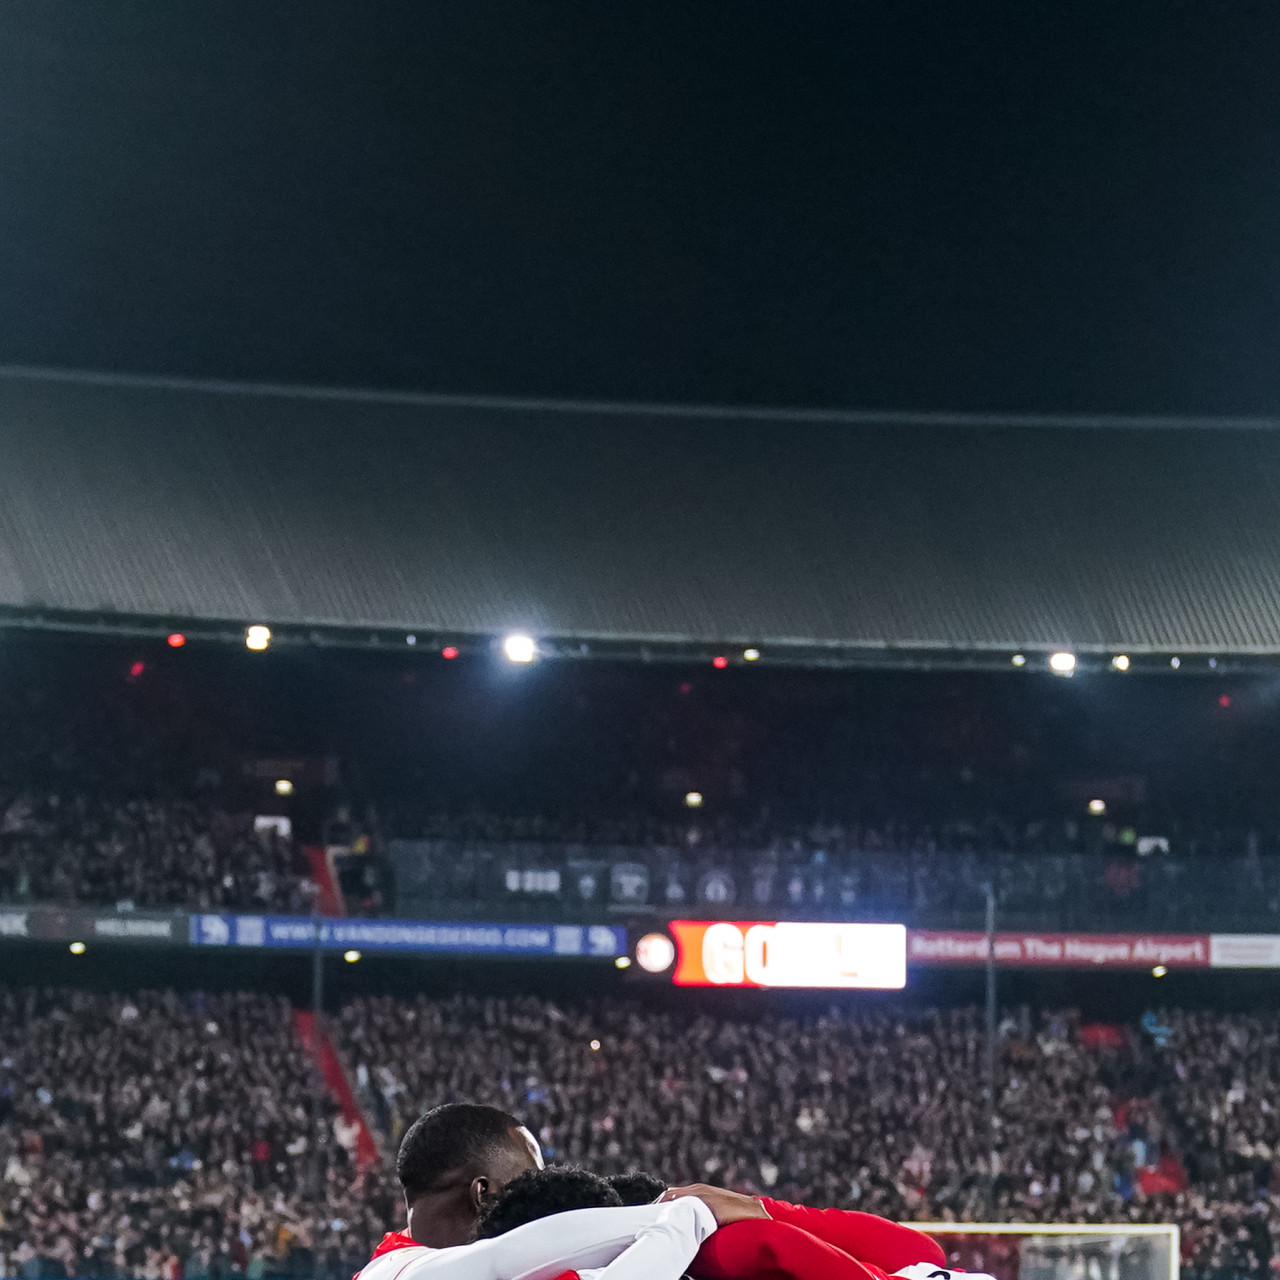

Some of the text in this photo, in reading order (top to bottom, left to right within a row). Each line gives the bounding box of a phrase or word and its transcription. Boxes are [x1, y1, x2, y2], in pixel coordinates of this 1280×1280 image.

[1024, 937, 1061, 958] The
[1065, 937, 1128, 964] Hague
[1133, 937, 1204, 962] Airport
